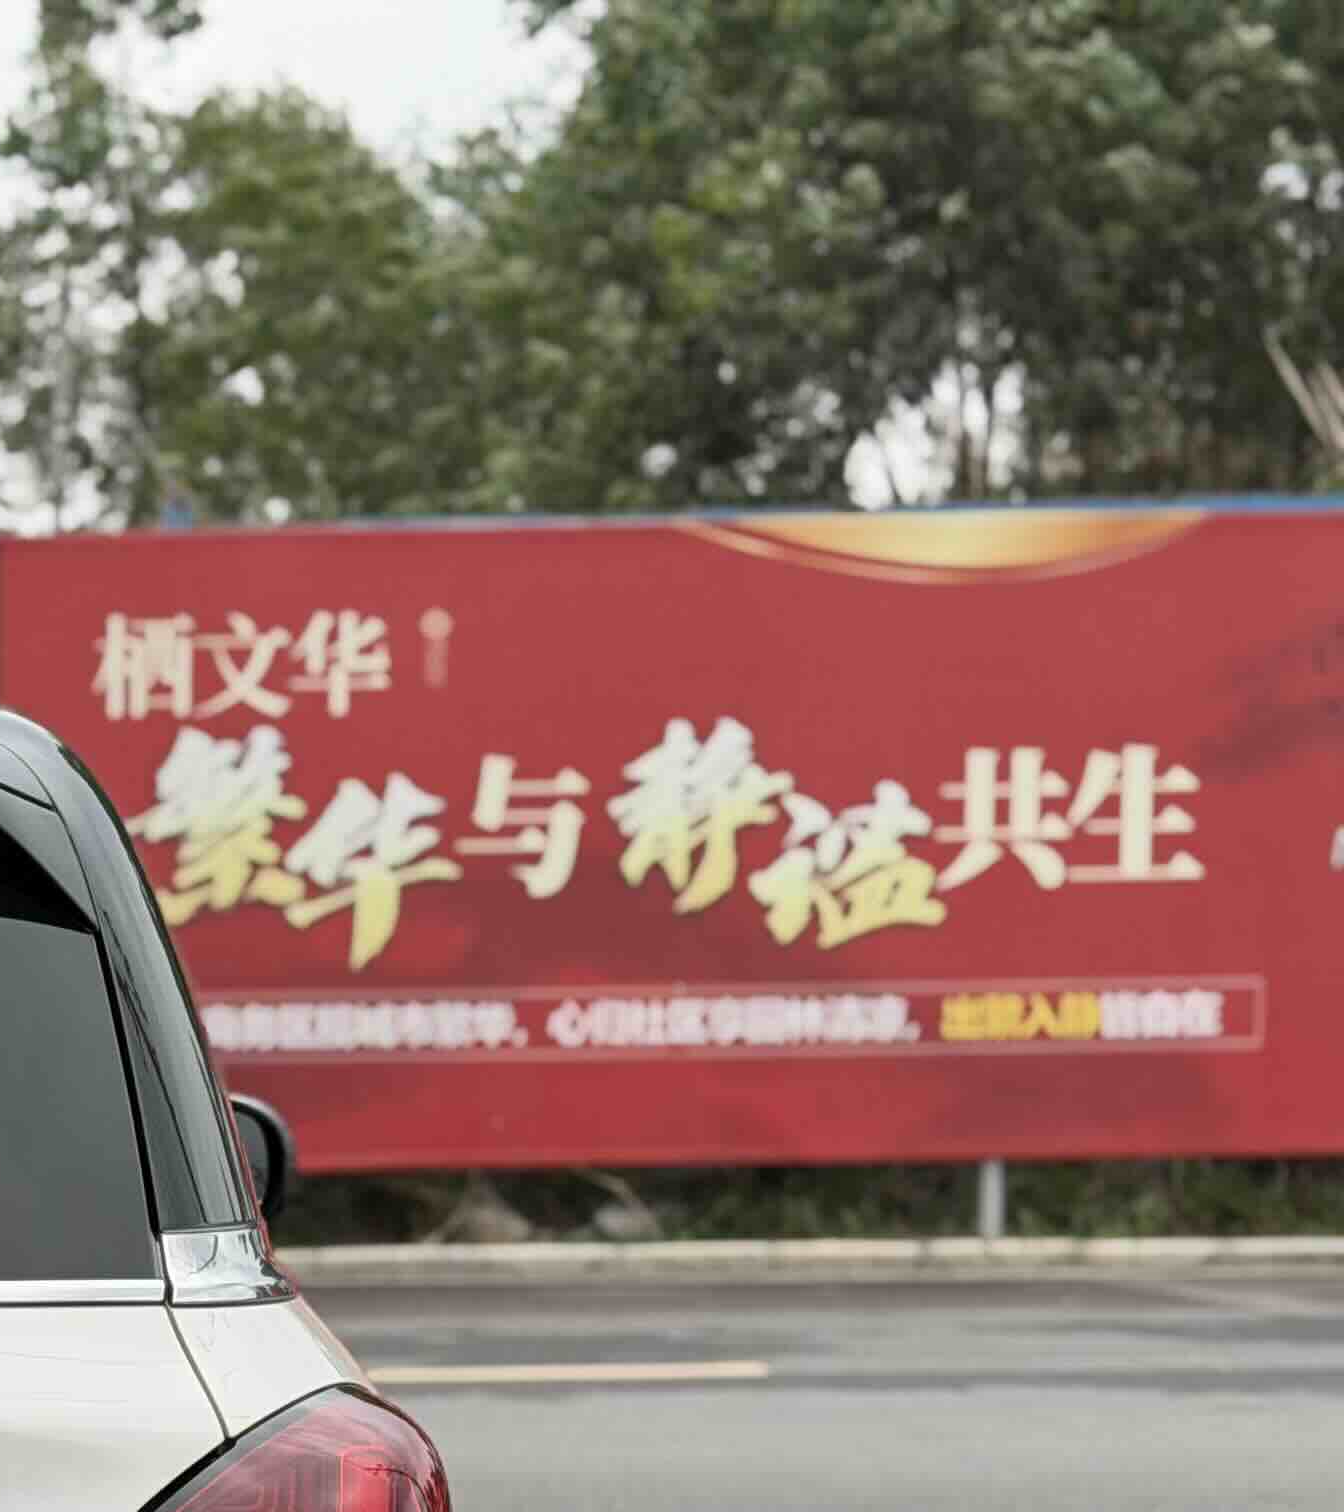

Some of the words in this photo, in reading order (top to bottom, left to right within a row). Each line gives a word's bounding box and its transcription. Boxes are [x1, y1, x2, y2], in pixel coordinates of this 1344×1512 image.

[124, 716, 1206, 974] 繁华与静谧共生
